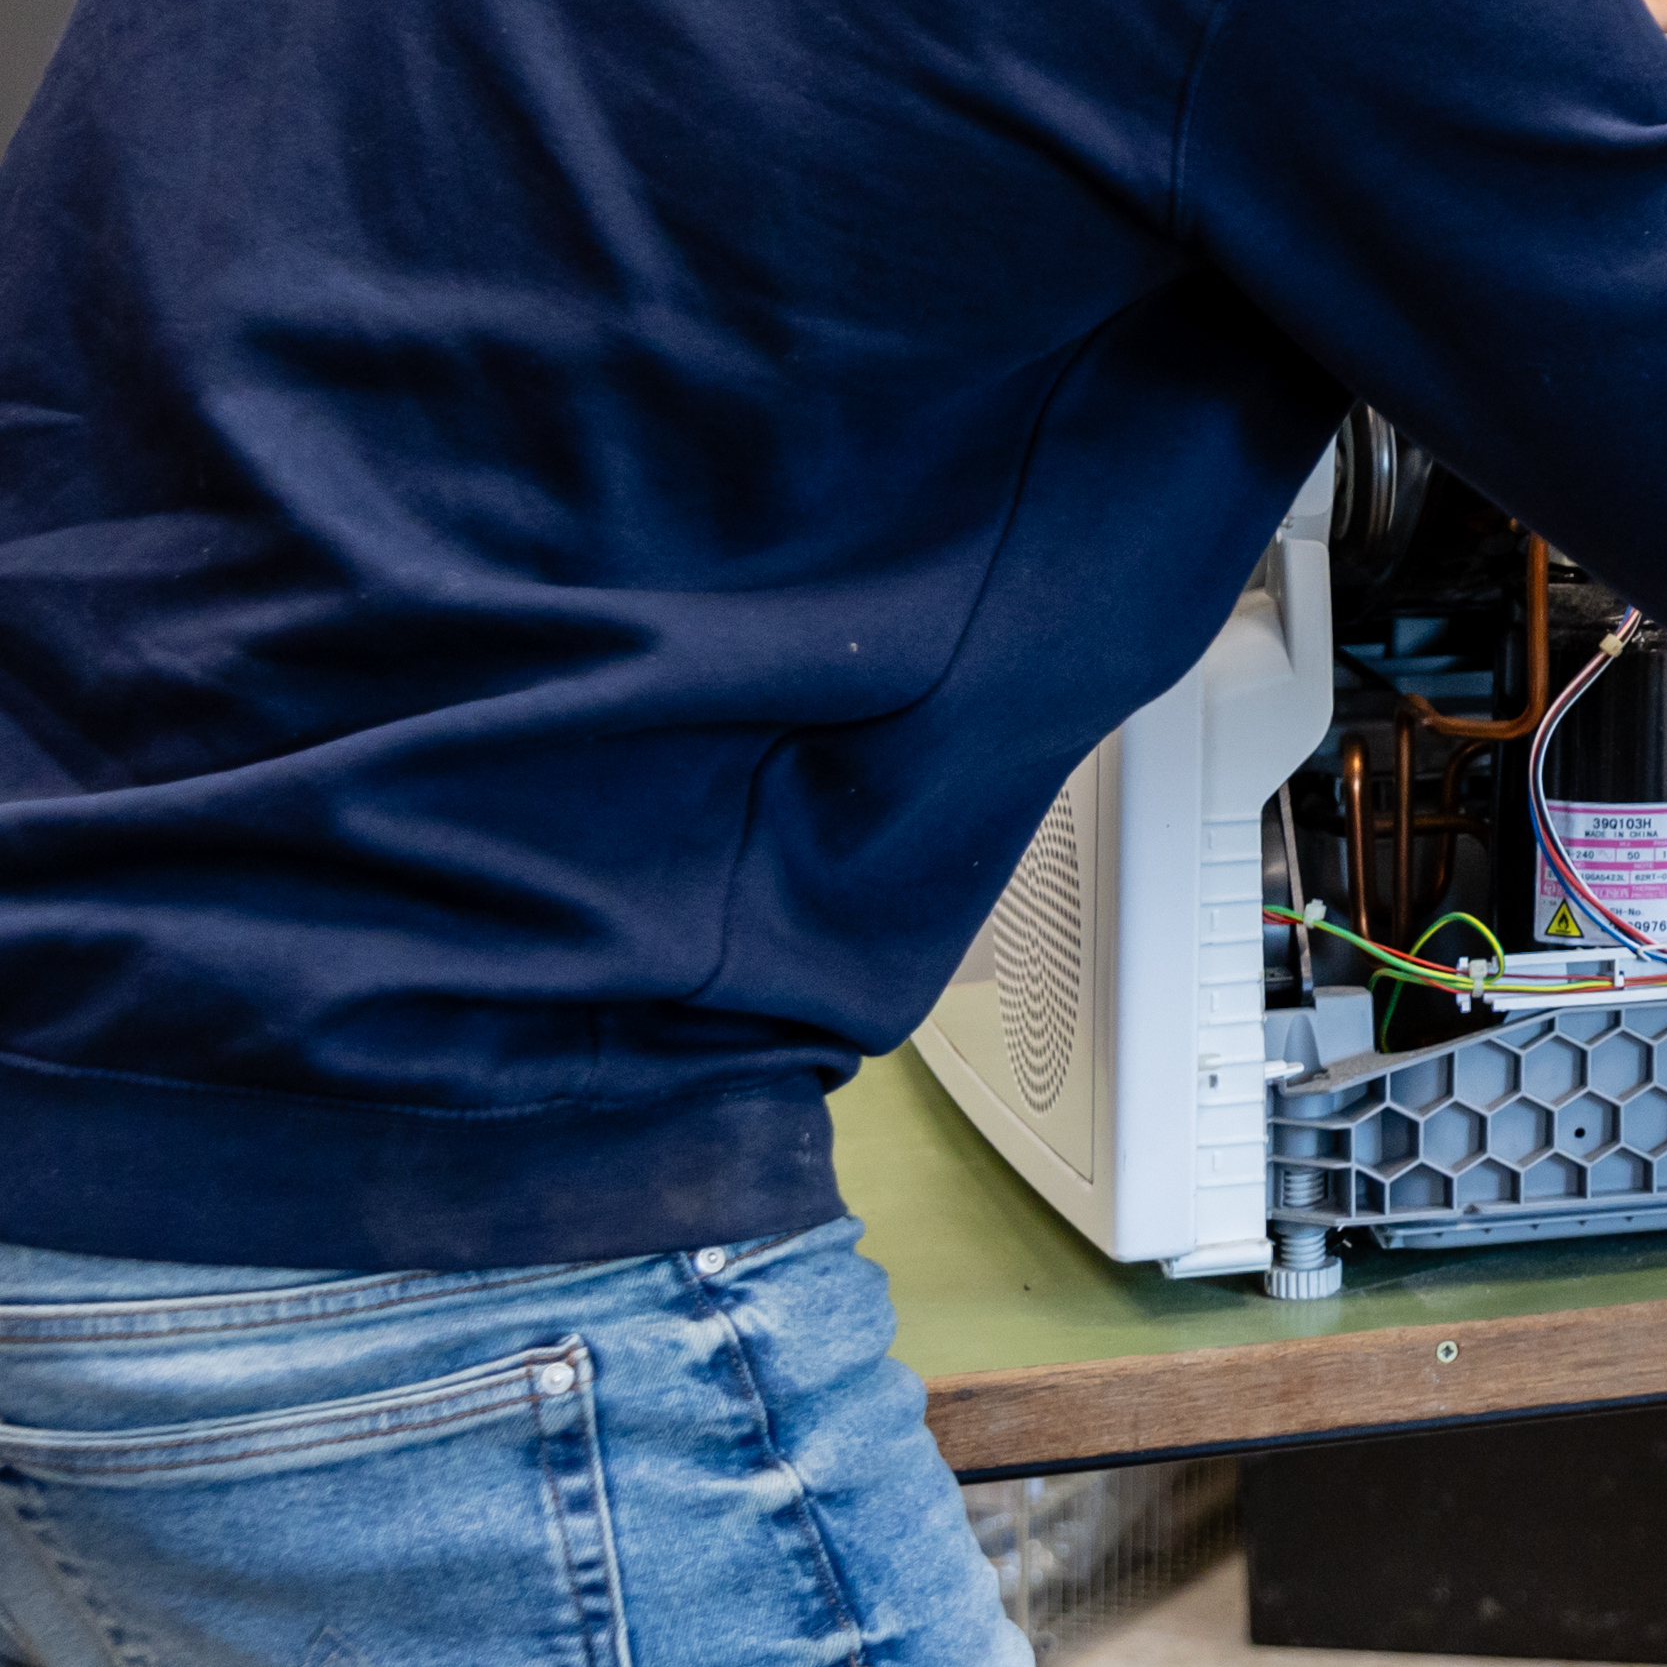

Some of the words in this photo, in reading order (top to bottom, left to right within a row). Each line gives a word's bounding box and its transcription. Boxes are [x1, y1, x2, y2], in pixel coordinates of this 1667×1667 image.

[1584, 830, 1606, 838] MADE
[1629, 830, 1658, 838] CHINA
[1627, 851, 1640, 860] 50
